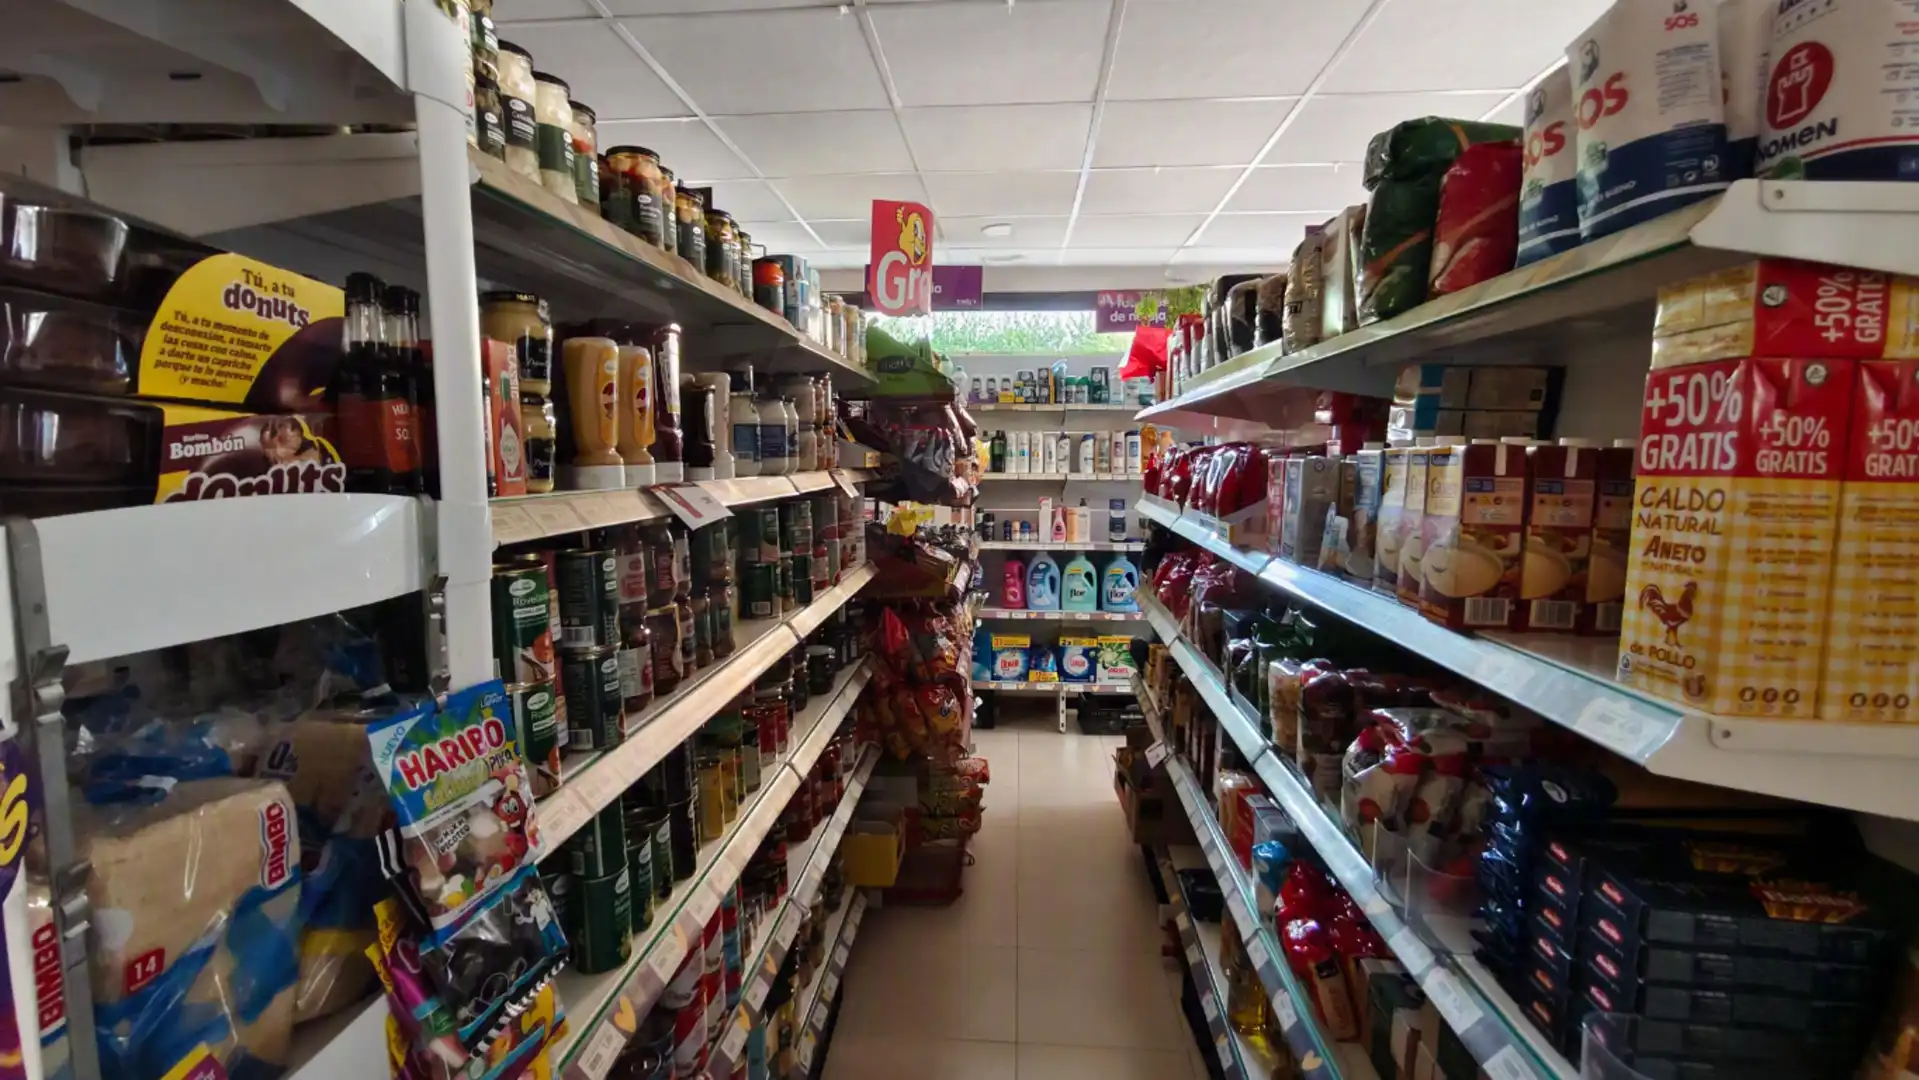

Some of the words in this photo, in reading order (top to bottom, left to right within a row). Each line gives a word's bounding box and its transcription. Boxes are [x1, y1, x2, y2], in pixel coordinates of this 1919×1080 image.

[1664, 13, 1698, 31] SOS
[281, 283, 295, 298] tu
[223, 283, 310, 328] donuts
[1110, 311, 1126, 322] de
[1854, 272, 1884, 343] GRATIS
[1646, 371, 1744, 427] +50%
[1759, 415, 1830, 448] +50%
[170, 434, 244, 460] Bombón
[1640, 431, 1738, 471] GRATIS
[1756, 450, 1828, 475] GRATIS
[1865, 453, 1919, 477] GRAT
[1640, 486, 1725, 512] CALDO
[1636, 512, 1723, 536] NATURAL
[1649, 645, 1696, 670] POLLO
[380, 725, 406, 766] NUEVO
[398, 719, 505, 789] HARIBO
[265, 800, 291, 886] BIMBO
[32, 921, 66, 1030] BIMBO
[134, 954, 157, 980] 14
